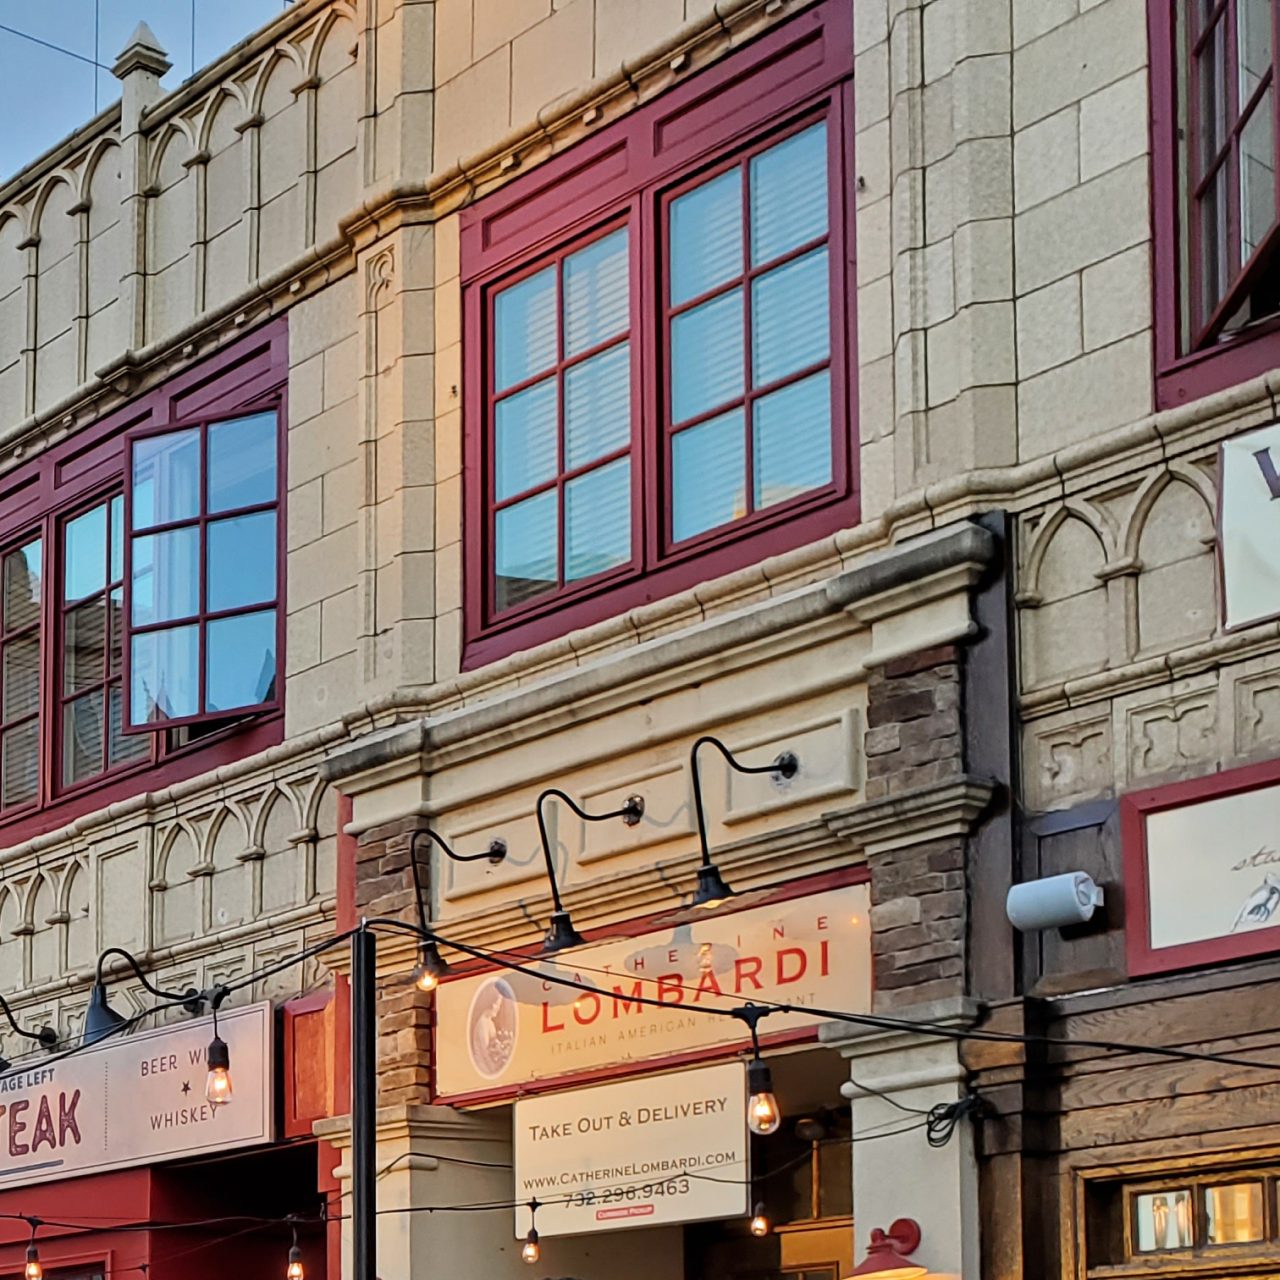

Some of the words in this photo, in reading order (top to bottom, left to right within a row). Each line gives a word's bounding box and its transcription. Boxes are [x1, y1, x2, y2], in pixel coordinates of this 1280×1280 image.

[541, 940, 830, 1034] LOMBARDI
[550, 1034, 608, 1055] ITALIAN
[617, 1016, 697, 1041] AMERICAN
[26, 1068, 55, 1087] LEFT
[140, 1054, 178, 1077] BEER
[150, 1103, 218, 1131] WHISKEY
[618, 1111, 632, 1127] &
[563, 1178, 690, 1209] 732.296.9463
